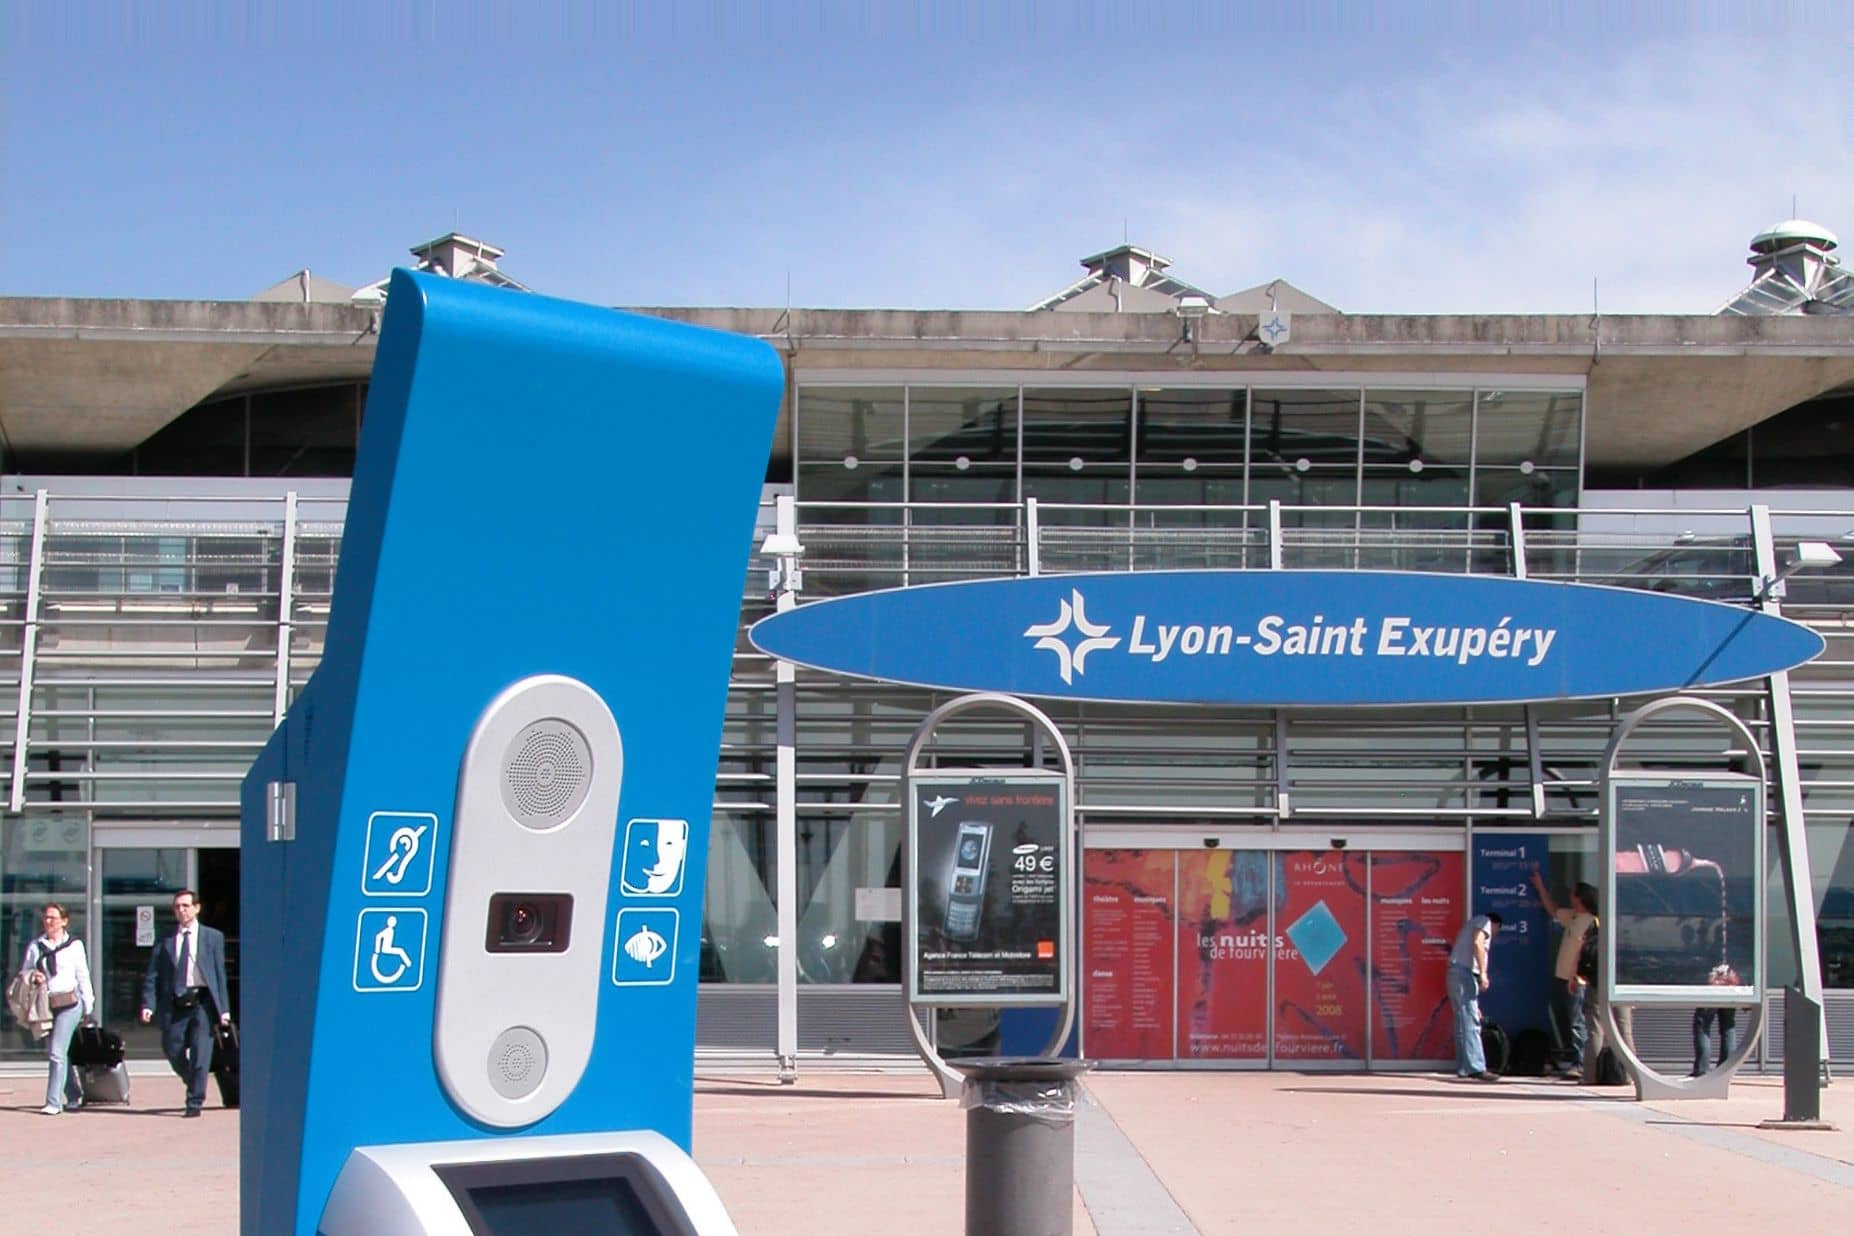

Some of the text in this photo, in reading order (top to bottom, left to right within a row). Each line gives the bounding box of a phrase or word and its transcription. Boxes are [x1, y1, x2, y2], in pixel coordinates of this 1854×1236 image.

[1129, 614, 1557, 666] Lyon-Saint Exupéry
[1480, 846, 1526, 859] Terminal 1
[1014, 855, 1055, 872] 49 €
[1480, 883, 1527, 897] Terminal 2
[1519, 920, 1529, 934] 3
[1196, 933, 1217, 947] les
[1210, 946, 1226, 960] de
